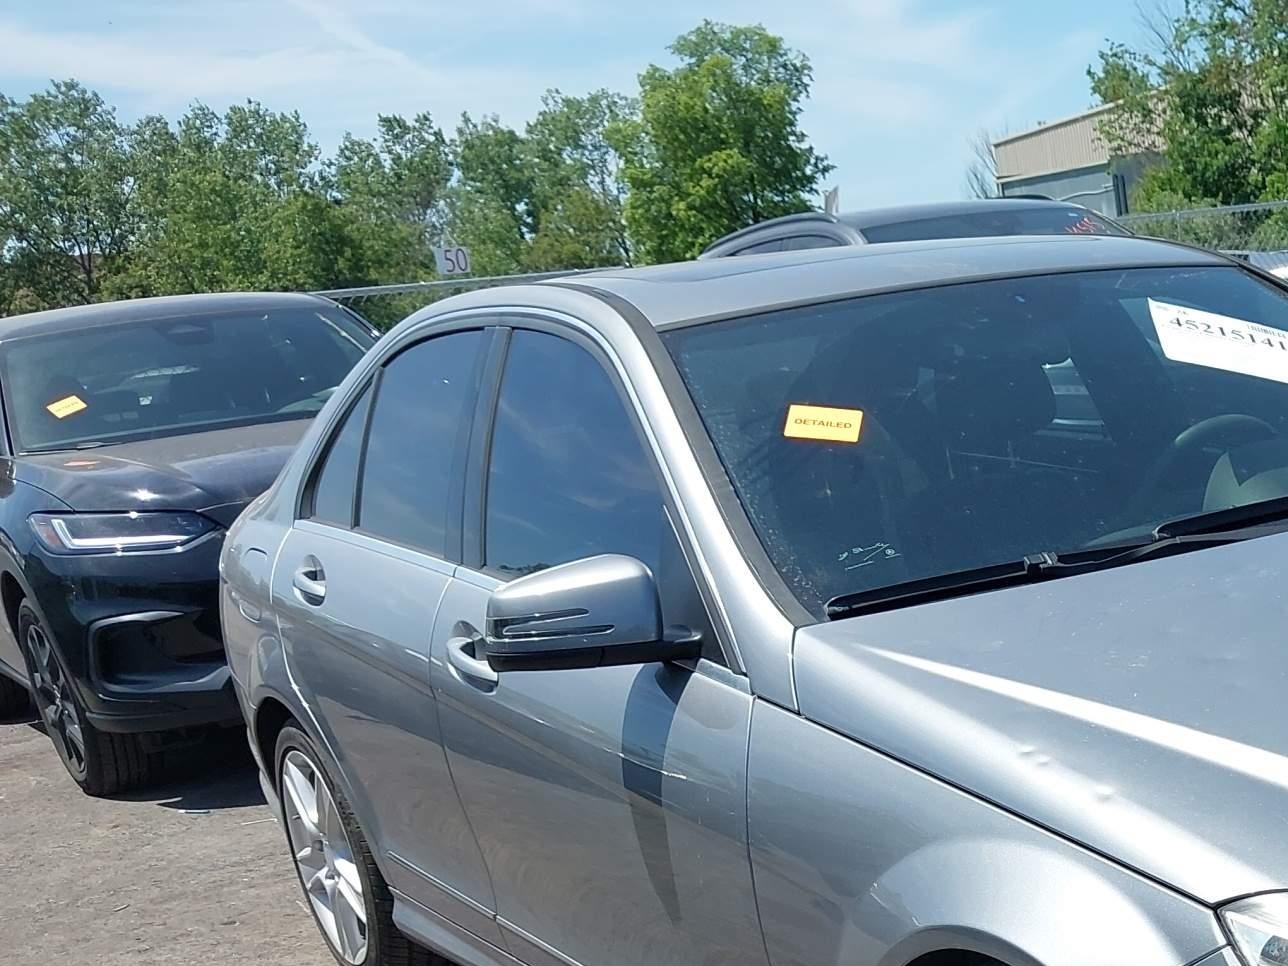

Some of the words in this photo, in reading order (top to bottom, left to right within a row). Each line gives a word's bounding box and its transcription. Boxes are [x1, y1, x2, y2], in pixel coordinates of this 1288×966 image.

[444, 248, 468, 272] 50
[1169, 317, 1287, 351] 45215141
[794, 418, 852, 429] DETAILED
